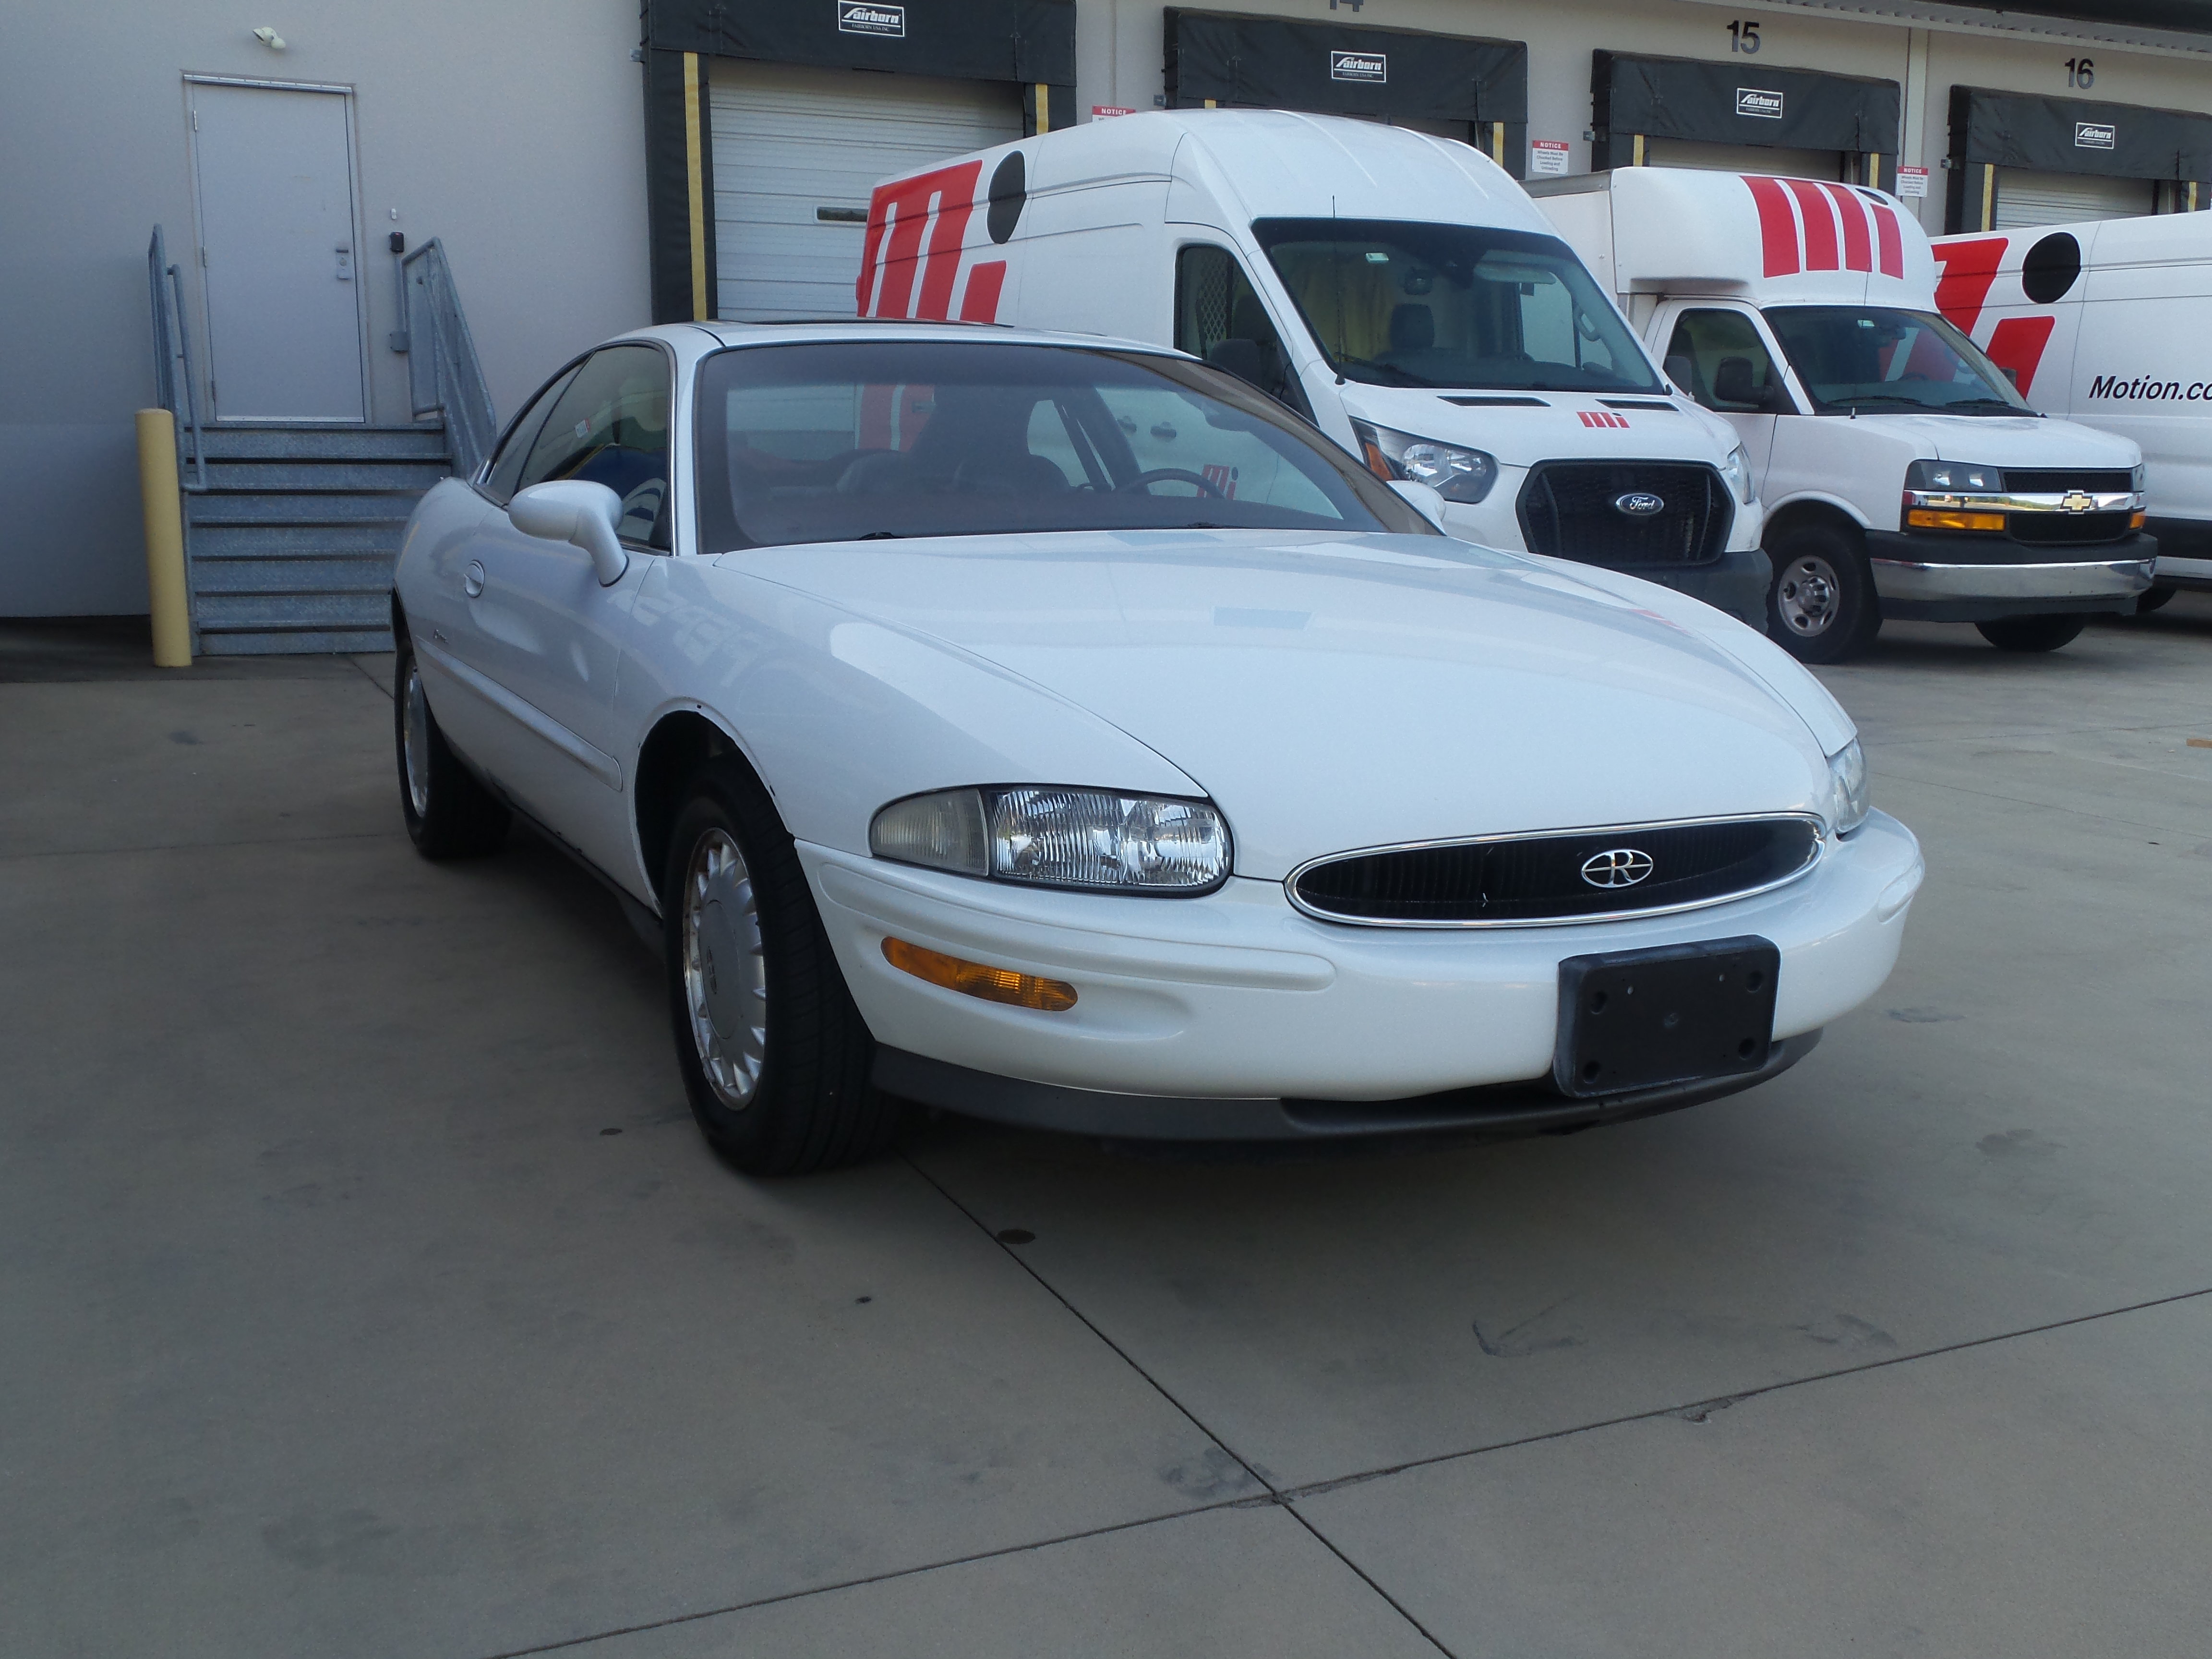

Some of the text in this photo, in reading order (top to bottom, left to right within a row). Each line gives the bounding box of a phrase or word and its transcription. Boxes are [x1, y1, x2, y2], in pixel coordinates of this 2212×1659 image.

[843, 7, 899, 24] Fairborn
[1727, 20, 1760, 54] 15
[1335, 57, 1382, 71] Fairborn
[2065, 58, 2094, 90] 16
[1741, 94, 1779, 107] Fairborn
[2079, 127, 2112, 139] Fairborn
[2089, 375, 2212, 400] Motion.co
[1630, 496, 1655, 510] Ford
